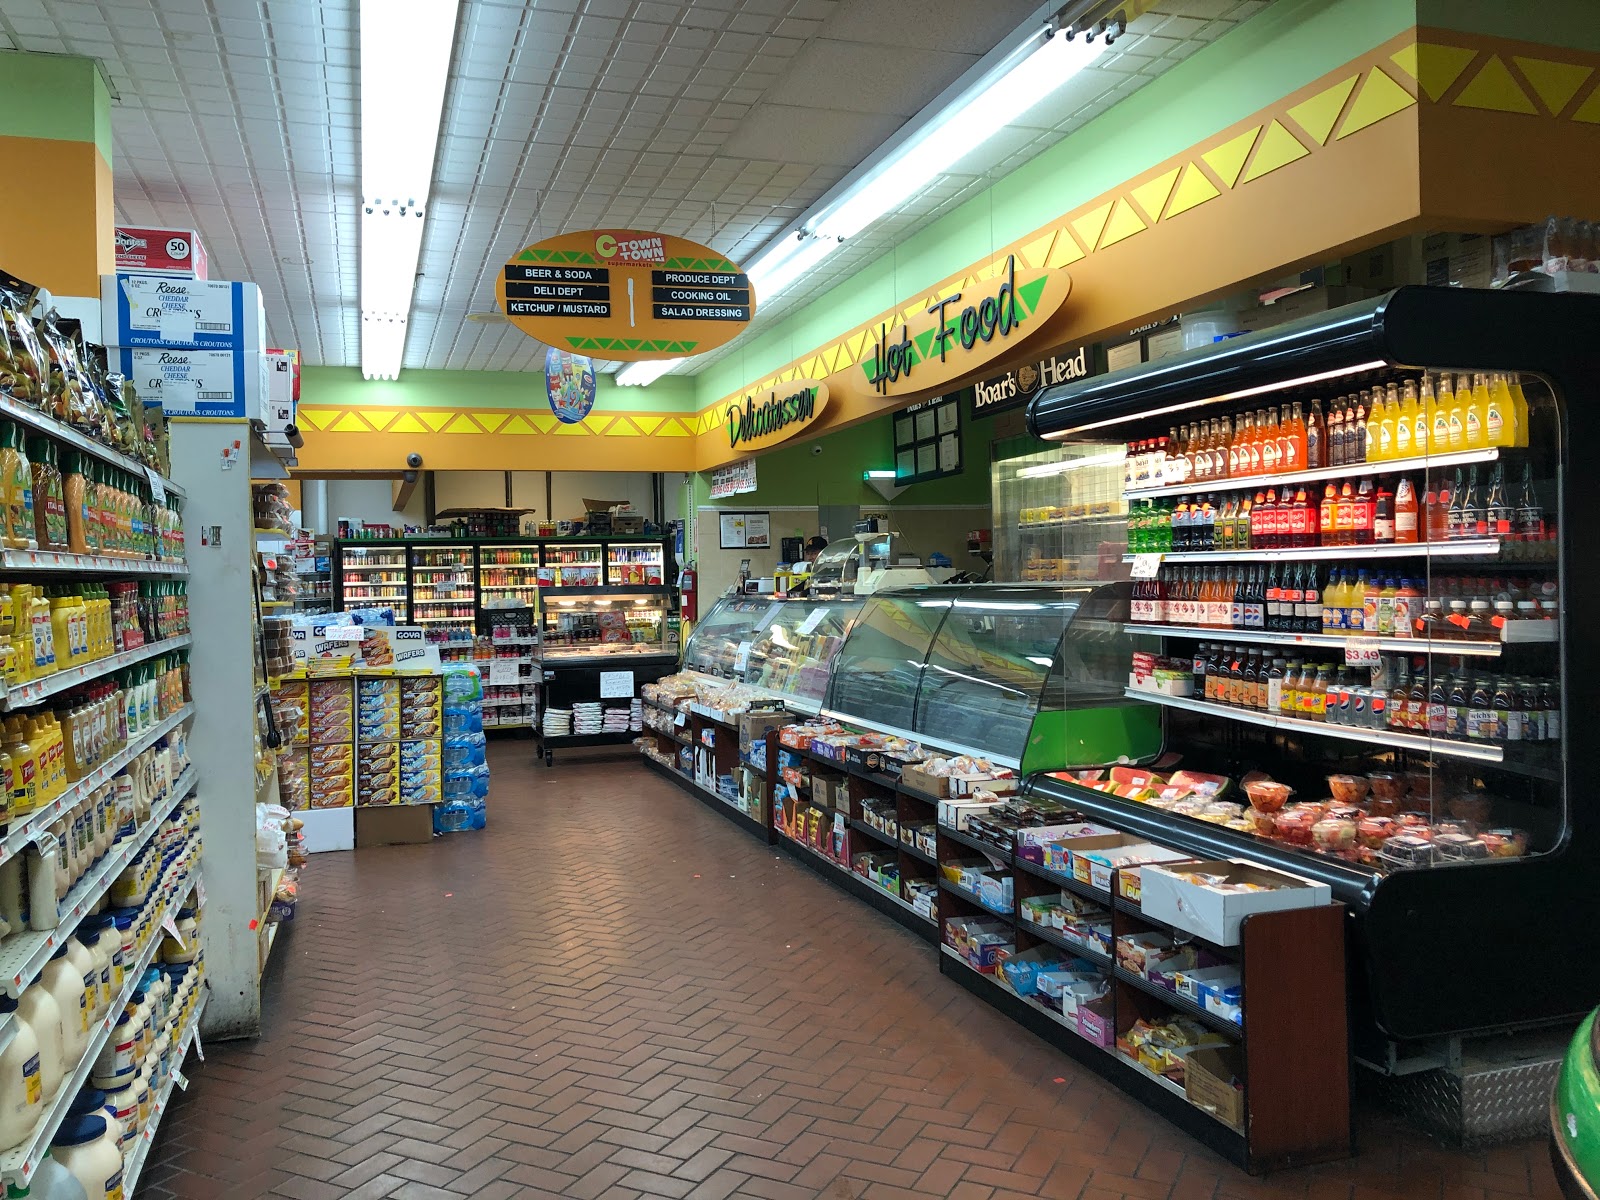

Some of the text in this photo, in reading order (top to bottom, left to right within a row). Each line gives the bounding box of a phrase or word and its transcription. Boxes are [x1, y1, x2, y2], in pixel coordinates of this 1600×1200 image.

[170, 241, 185, 252] 50
[618, 237, 662, 252] TOWN
[619, 247, 665, 261] TOWN
[525, 268, 592, 280] BEER & SODA
[665, 273, 736, 286] PRODUCE DEPT
[155, 281, 187, 295] Reese
[533, 286, 584, 297] DELI DEPT
[158, 295, 189, 303] CHEDDAR
[671, 290, 731, 301] COOKING OIL
[161, 301, 187, 309] CHEESE
[511, 303, 607, 315] KETCHUP / MUSTARD
[661, 307, 742, 318] SALAD DRESSING
[869, 254, 1020, 395] Hot Food
[130, 337, 165, 346] CROUTONS
[165, 339, 199, 347] CROUTONS
[157, 352, 189, 364] Reese
[974, 346, 1088, 409] Boar's Head
[167, 409, 201, 417] CROUTONS
[726, 386, 815, 449] Delicatessen
[397, 631, 421, 640] GOYA
[315, 640, 349, 654] WAFERS
[396, 649, 425, 662] WAFERS
[1345, 649, 1380, 661] $3.49
